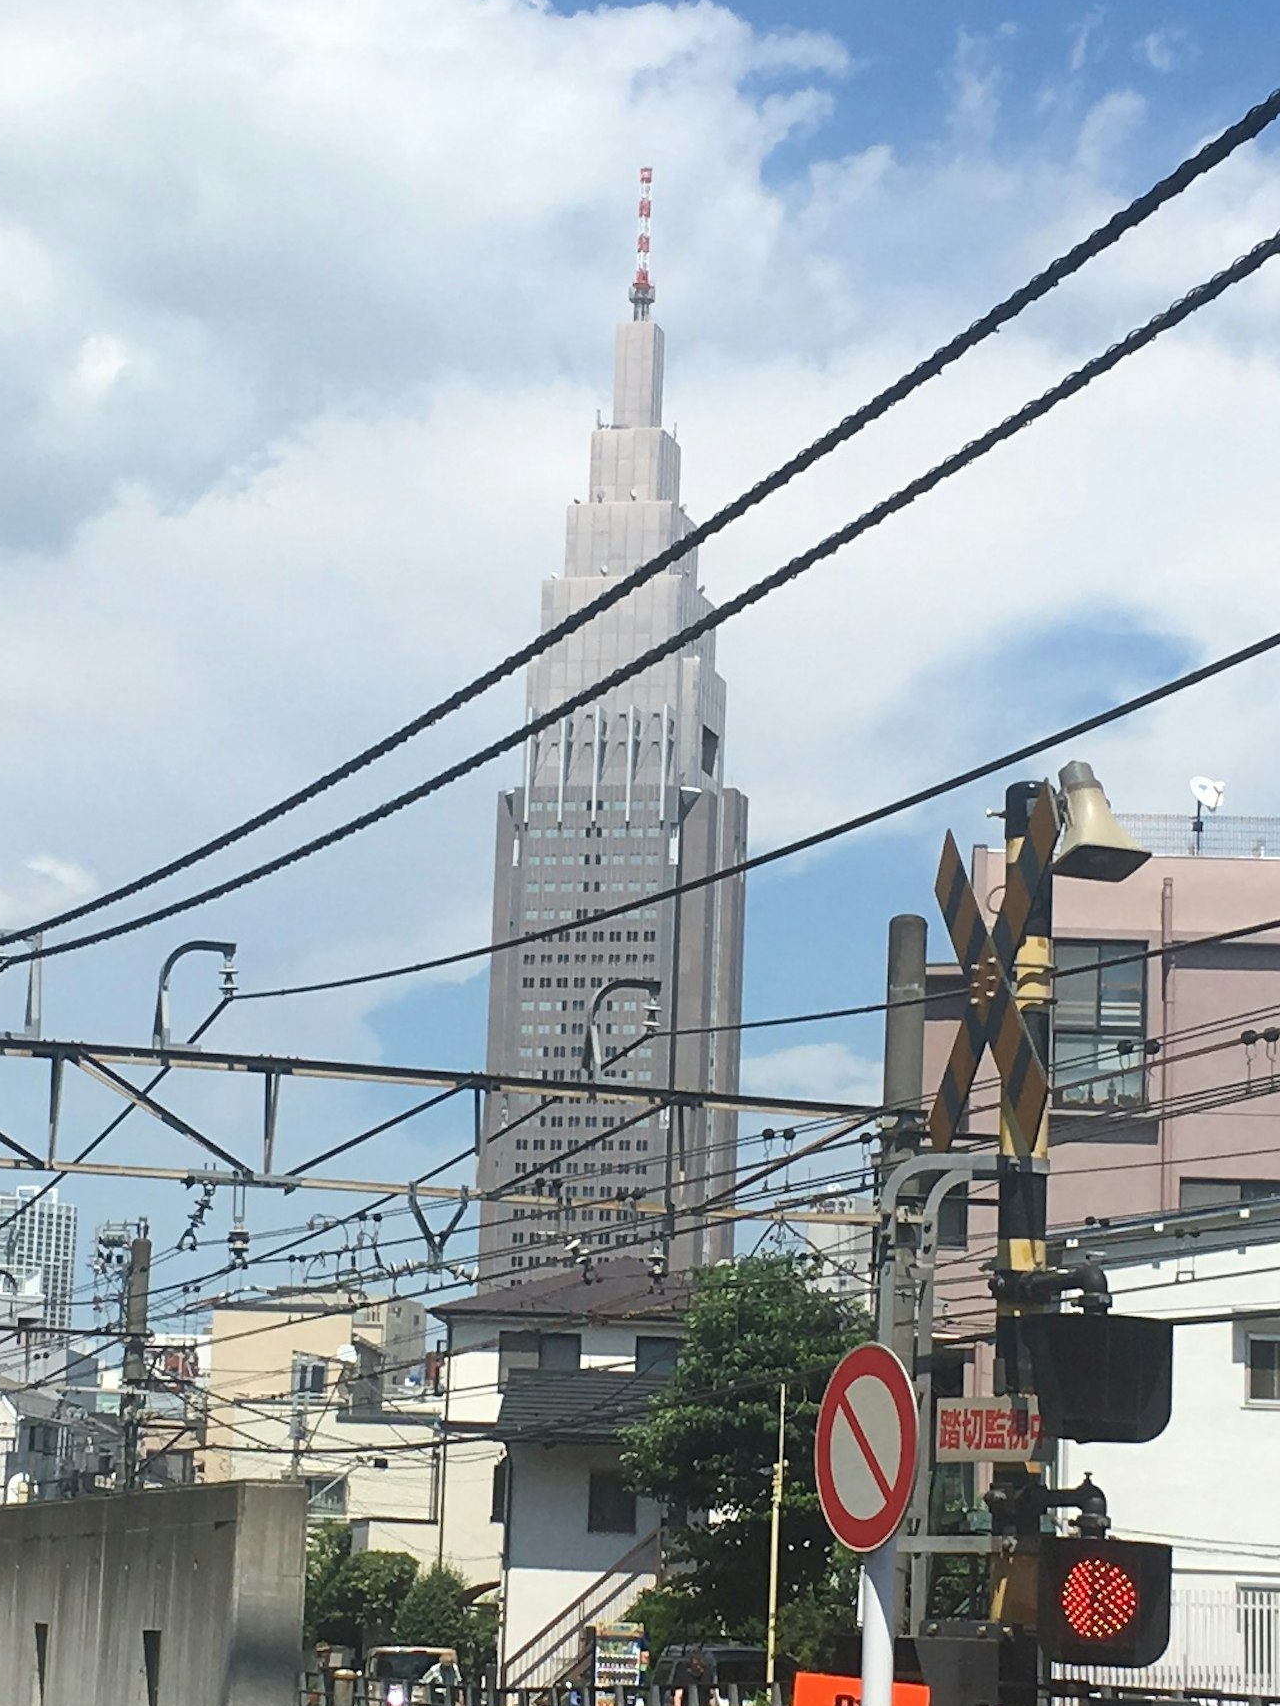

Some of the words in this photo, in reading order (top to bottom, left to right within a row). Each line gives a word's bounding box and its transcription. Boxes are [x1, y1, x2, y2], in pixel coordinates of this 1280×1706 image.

[939, 1408, 1046, 1450] 踏切監視中
